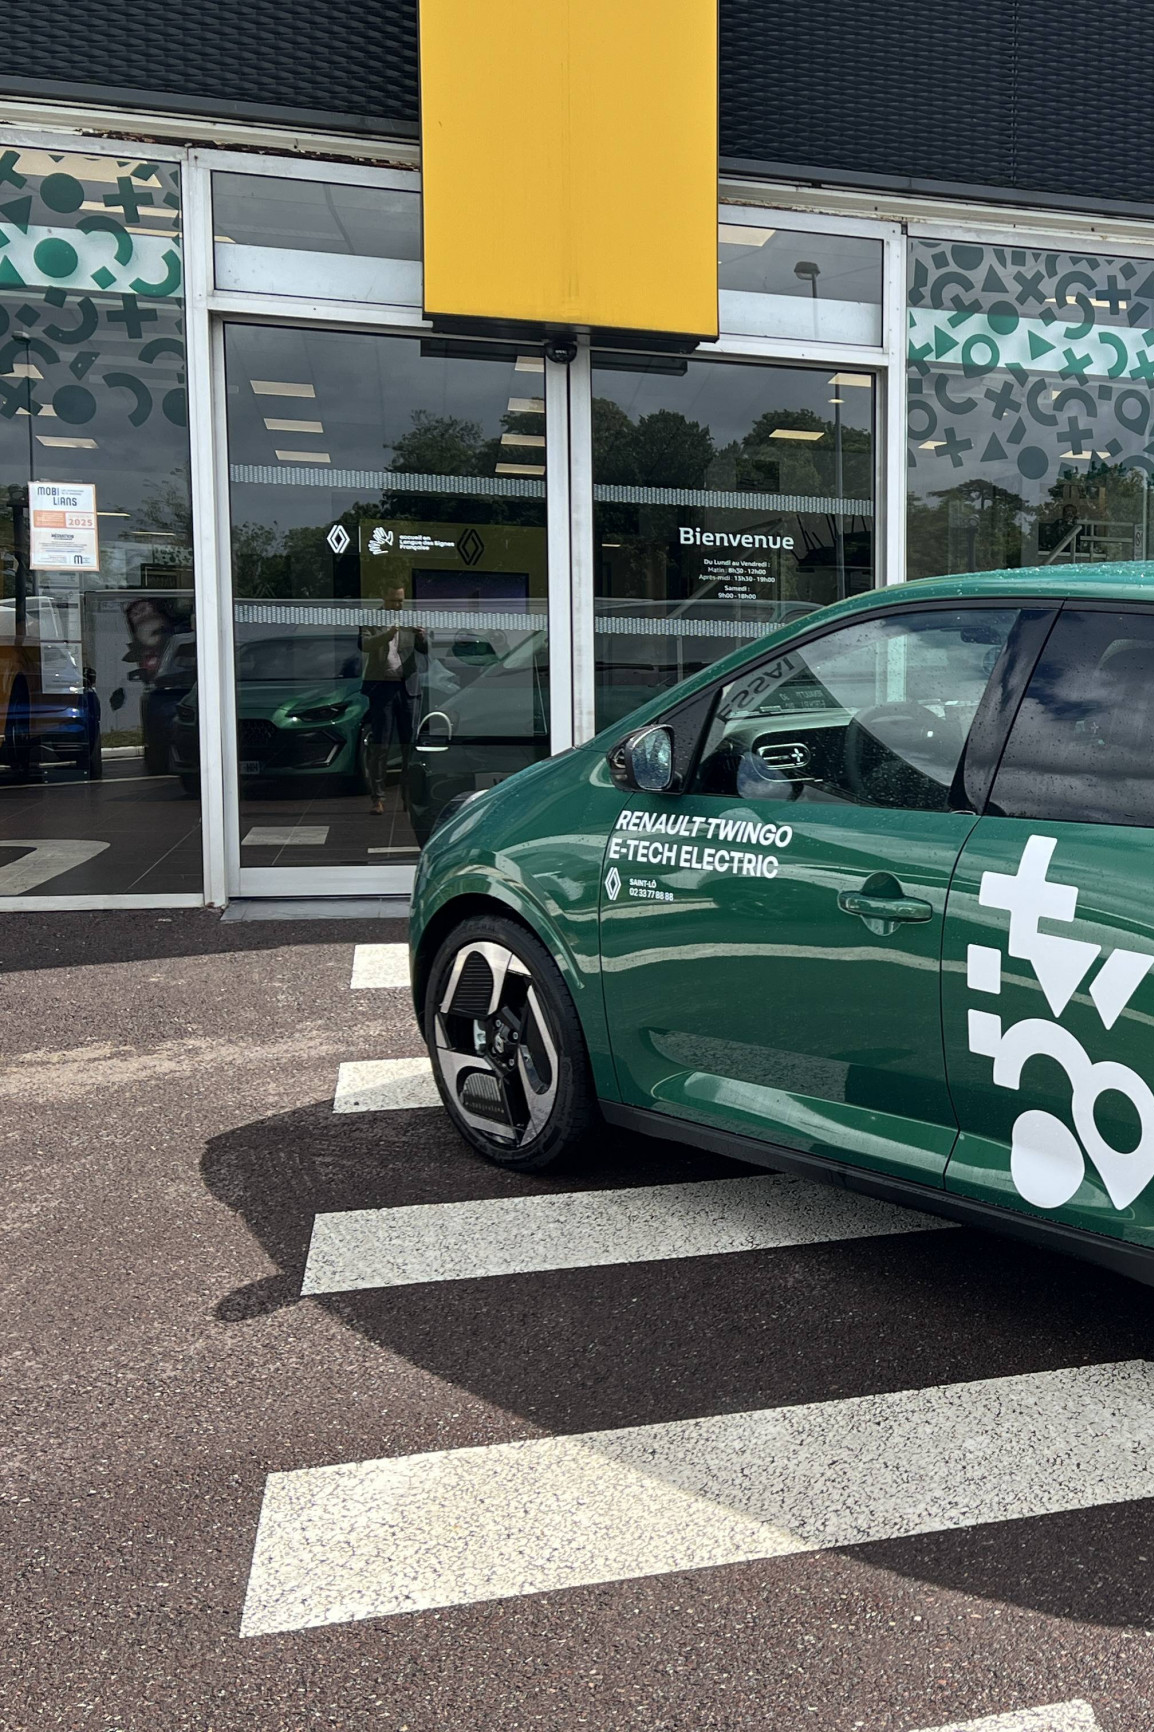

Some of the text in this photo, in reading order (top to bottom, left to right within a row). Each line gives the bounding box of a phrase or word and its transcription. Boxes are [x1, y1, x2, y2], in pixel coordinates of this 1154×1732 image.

[68, 518, 93, 527] 2025
[679, 527, 795, 549] Bienvenue
[615, 810, 793, 848] RENAULT TWINGO
[609, 837, 779, 879] E-TECH ELECTRIC
[629, 878, 657, 888] SAINT-LÔ
[629, 887, 674, 901] 02 33 77 88 88
